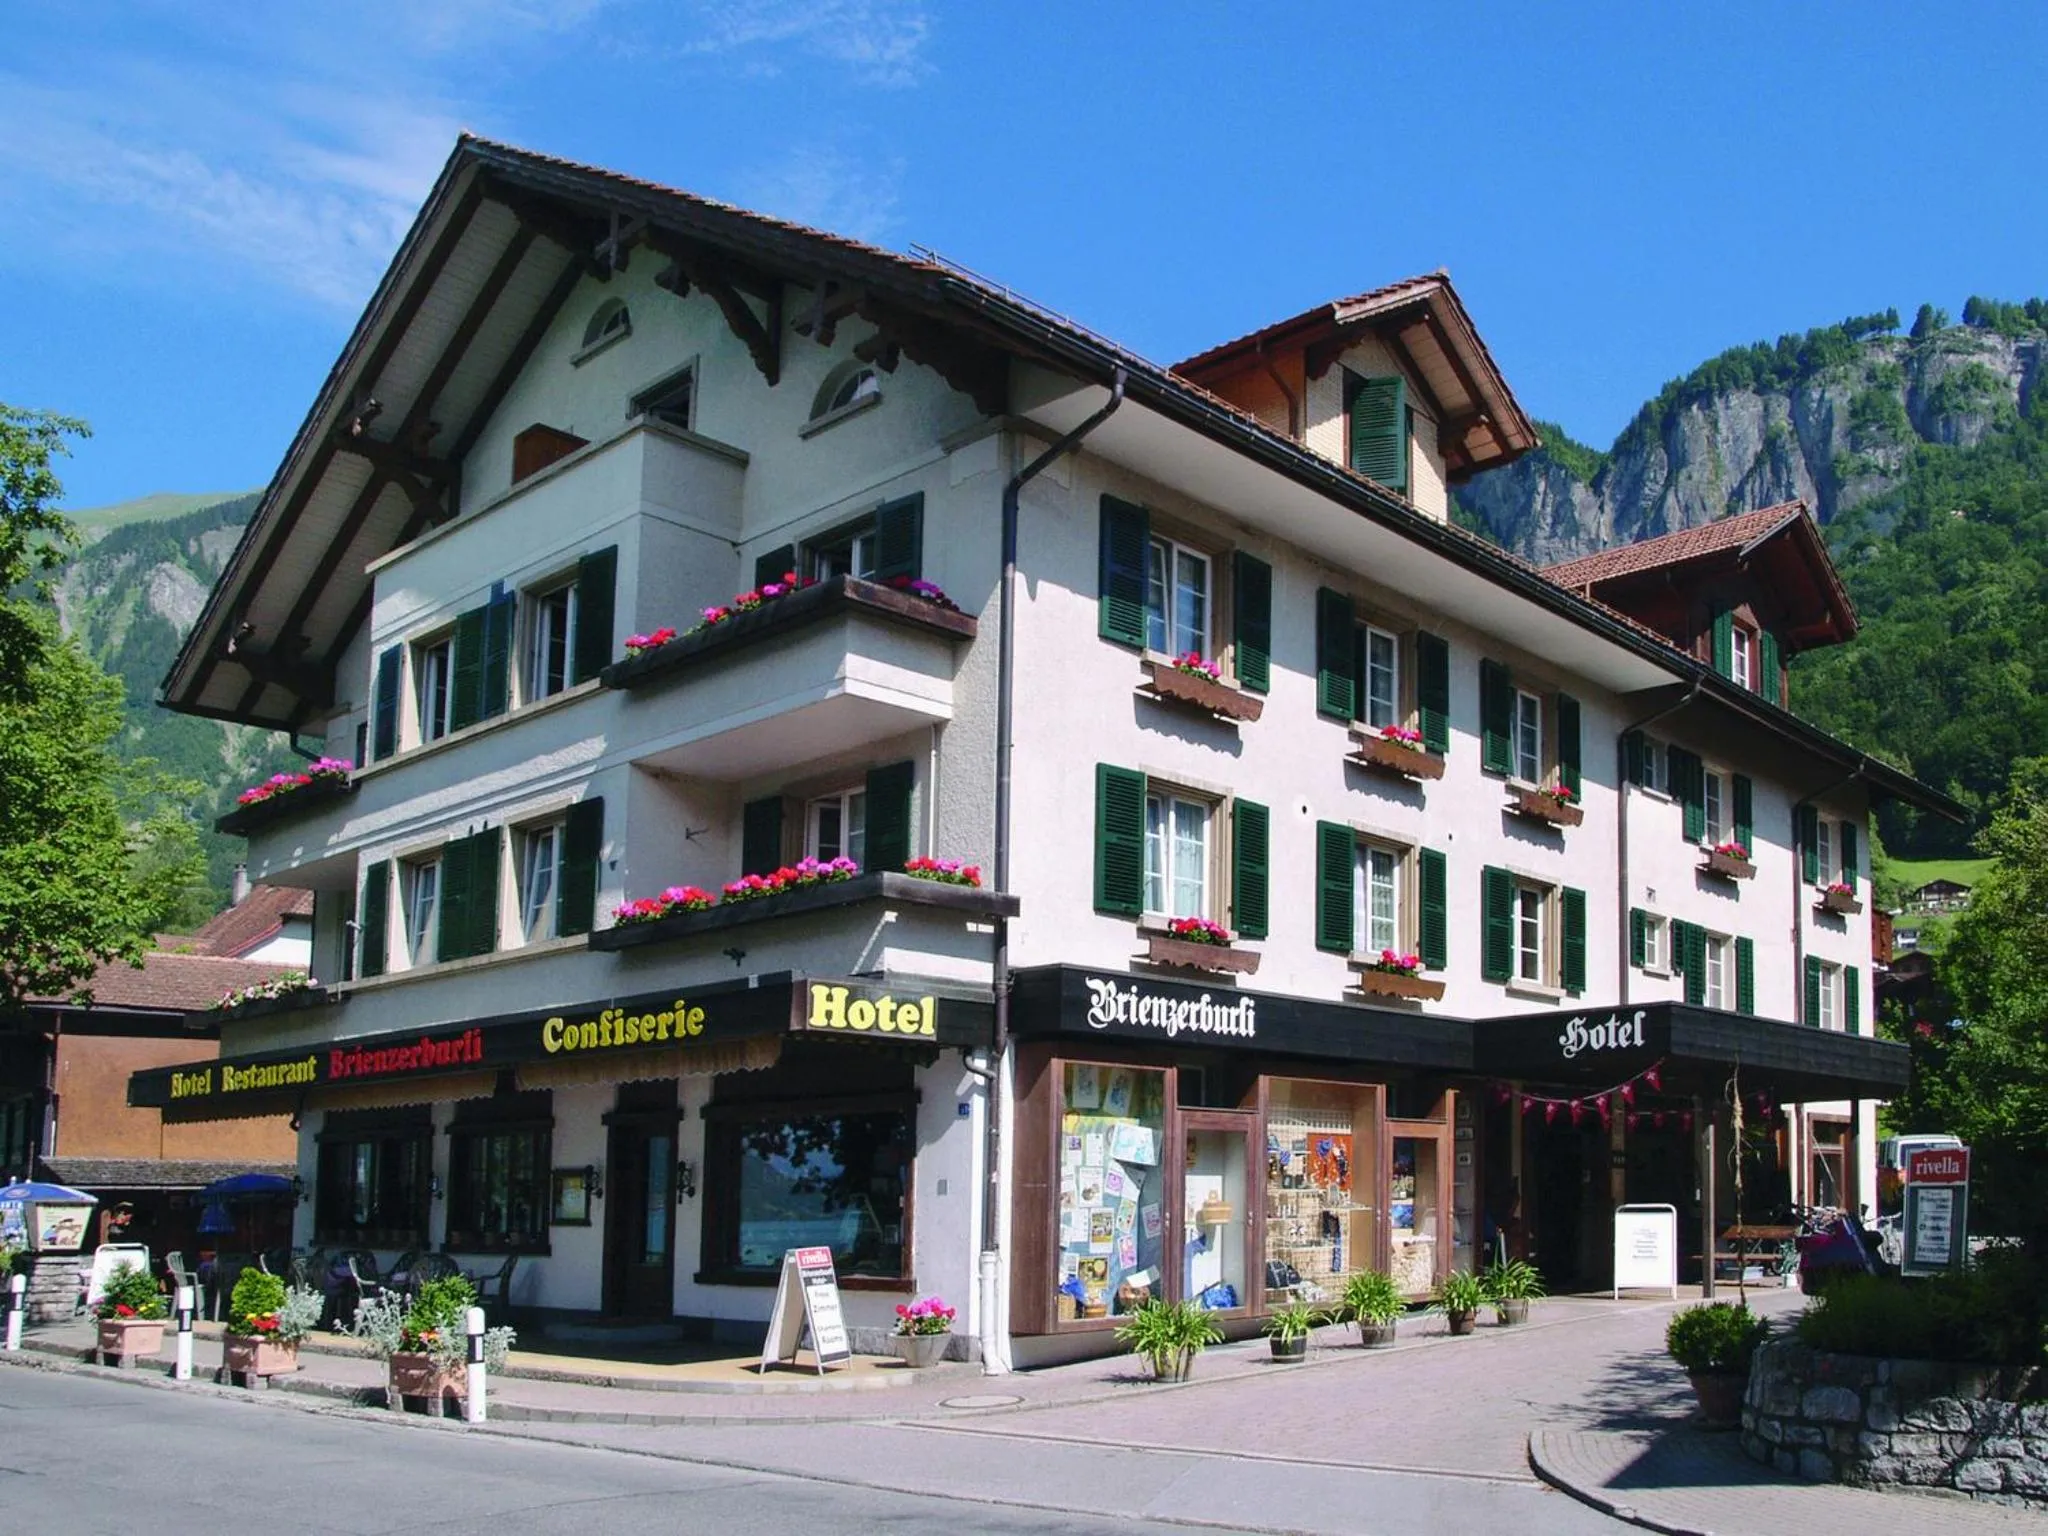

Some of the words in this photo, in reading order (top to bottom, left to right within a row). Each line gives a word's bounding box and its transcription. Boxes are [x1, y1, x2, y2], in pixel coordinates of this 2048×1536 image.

[542, 1000, 705, 1054] Confiserie
[808, 985, 935, 1035] Hotel
[1085, 976, 1256, 1037] Brienzerburli
[1559, 1010, 1646, 1058] Hotel
[170, 1068, 212, 1098] Hotel
[221, 1055, 317, 1092] Restaurant
[328, 1027, 483, 1079] Brienzerburli
[1915, 1157, 1960, 1175] rivella
[802, 1251, 828, 1265] rivella
